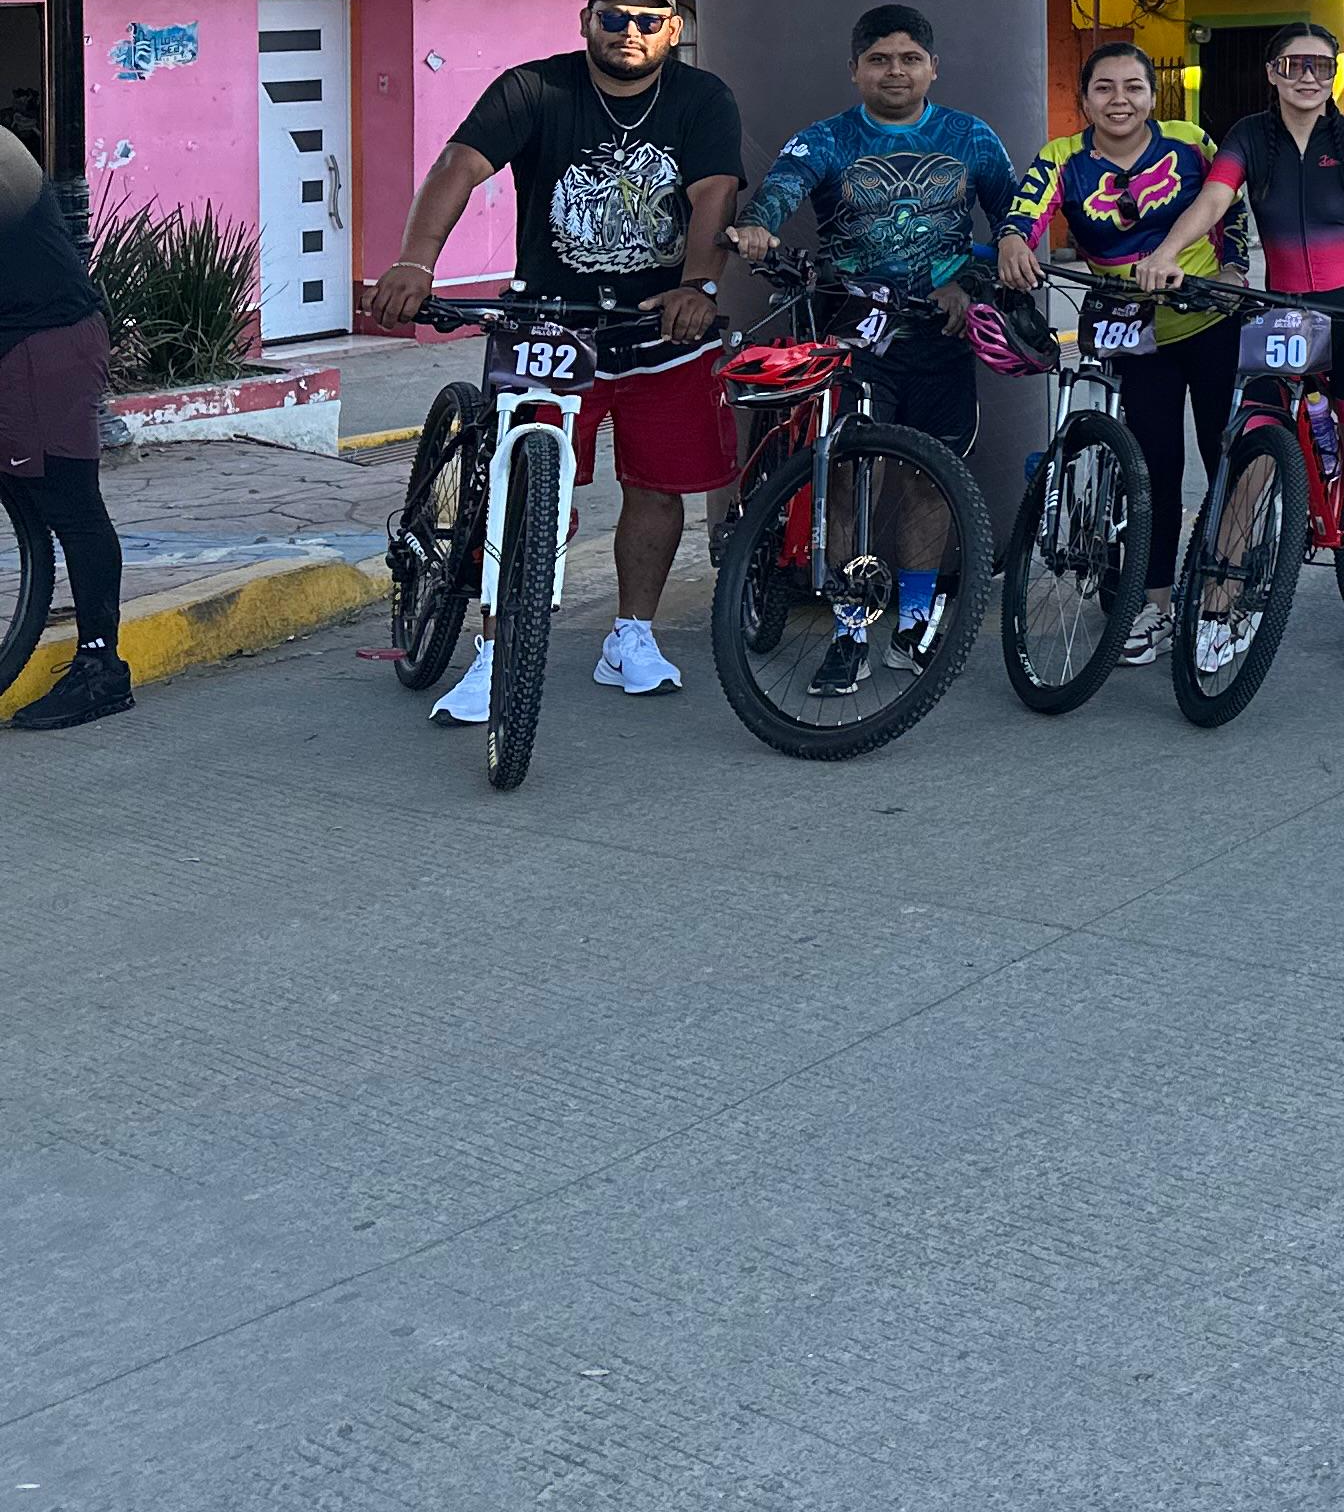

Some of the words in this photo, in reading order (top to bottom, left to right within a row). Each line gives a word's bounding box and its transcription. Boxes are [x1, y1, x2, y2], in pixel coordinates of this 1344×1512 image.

[1093, 319, 1142, 350] 188
[1265, 334, 1308, 369] 50
[512, 341, 578, 379] 132
